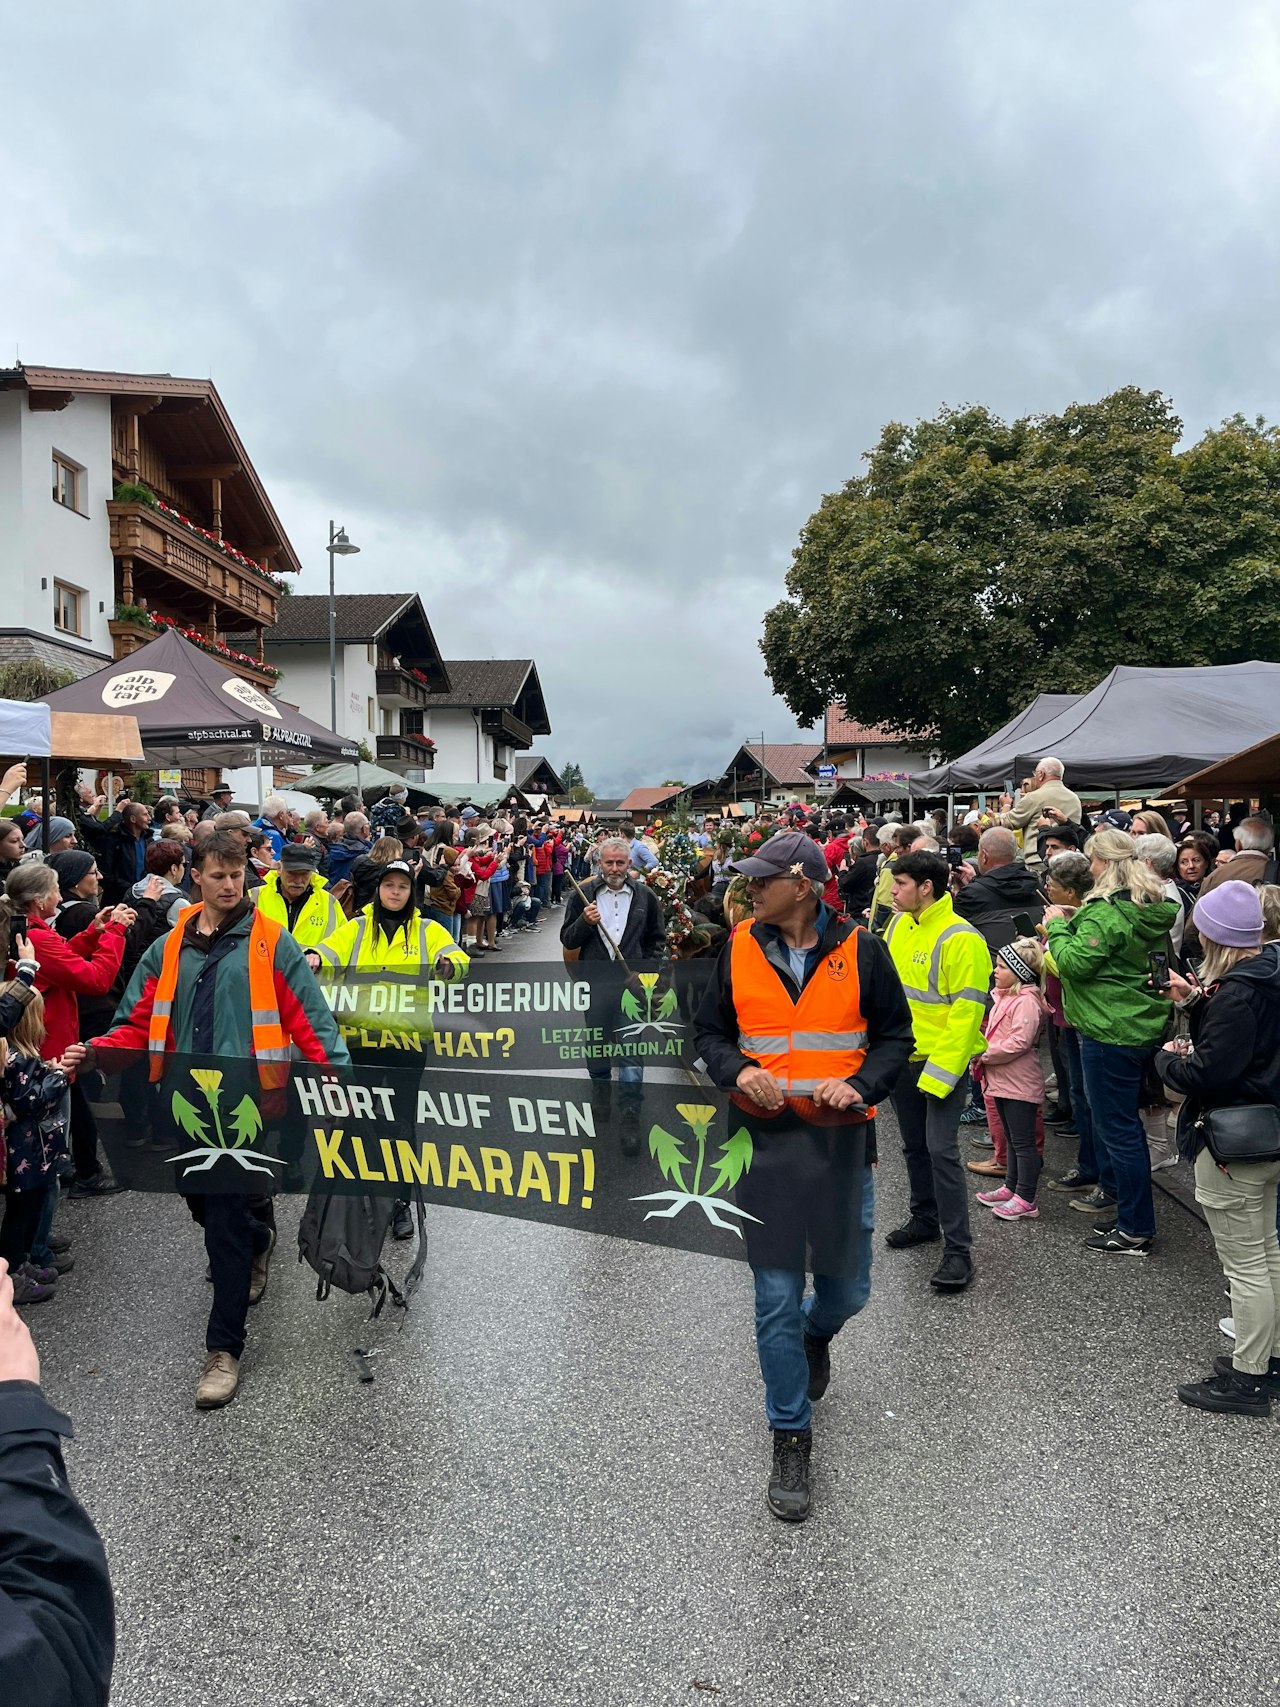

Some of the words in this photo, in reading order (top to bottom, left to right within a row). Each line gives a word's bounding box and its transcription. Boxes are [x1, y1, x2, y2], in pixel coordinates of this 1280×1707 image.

[112, 683, 158, 695] bach
[125, 675, 155, 685] alp
[113, 691, 141, 700] tal
[187, 729, 252, 741] alpbachtal.at
[272, 727, 313, 748] ALPBACHTAL
[320, 984, 359, 1012] NN
[369, 984, 416, 1013] DIE
[428, 980, 591, 1013] REGIERUNG
[339, 1025, 423, 1053] PLAN
[433, 1027, 516, 1058] HAT?
[541, 1027, 604, 1044] LETZTE
[559, 1039, 684, 1060] GENERATION.AT
[294, 1075, 396, 1122] HÖRT
[416, 1090, 491, 1129] AUF
[508, 1096, 597, 1138] DEN
[313, 1128, 596, 1209] KLIMARAT!
